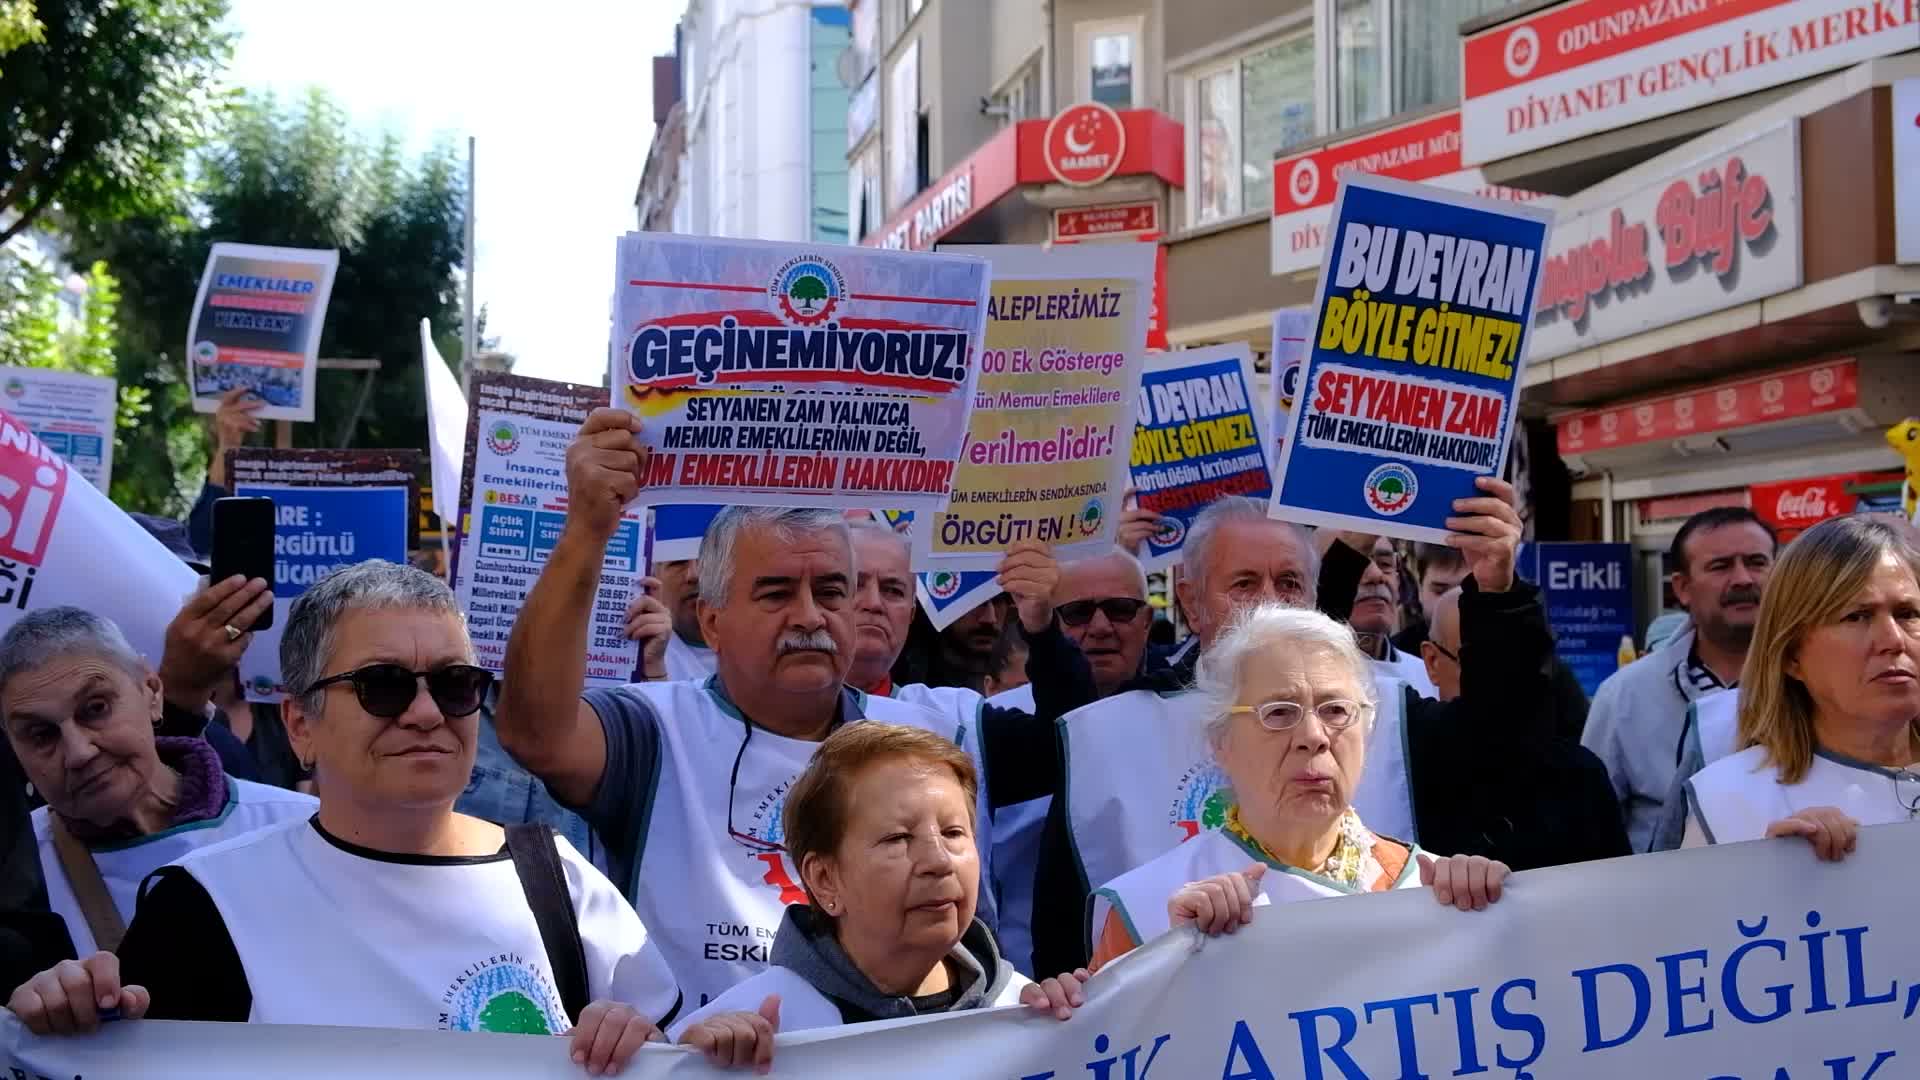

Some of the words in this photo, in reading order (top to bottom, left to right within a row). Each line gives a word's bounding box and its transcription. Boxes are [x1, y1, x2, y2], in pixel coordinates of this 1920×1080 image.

[1506, 74, 1633, 135] DİYANET
[1637, 30, 1779, 97] GENÇLİK
[1656, 157, 1775, 273] Büfe
[1291, 223, 1328, 253] DİY
[1335, 222, 1399, 293] BU
[1395, 230, 1535, 316] DEVRAN
[987, 288, 1121, 321] ALEPLERİMİZ
[1319, 289, 1418, 360] BÖYLE
[1413, 302, 1522, 381] GİTMEZ!
[632, 318, 967, 383] GEÇİNEMİYORUZ!
[982, 350, 1005, 373] 00
[1011, 350, 1033, 373] Ek
[1039, 349, 1124, 376] Gösterge
[686, 397, 782, 422] SEYYANEN
[784, 399, 825, 424] ZAM
[830, 401, 910, 426] YALNIZCA
[999, 393, 1049, 409] Memur
[1052, 386, 1121, 407] Emeklilere
[1136, 386, 1153, 427] U
[1150, 371, 1248, 425] DEVRAN
[1314, 370, 1448, 431] SEYYANEN
[1445, 391, 1502, 439] ZAM
[663, 426, 734, 449] MEMUR
[737, 423, 873, 451] EMEKLİLERİNİN
[874, 426, 927, 457] DEĞİL,
[1130, 426, 1184, 468] BÖYLE
[1179, 413, 1257, 458] GİTMEZ!
[1306, 411, 1339, 442] TÜM
[1337, 418, 1429, 457] EMEKLİLERİN
[1427, 433, 1497, 468] HAKKIDIR!
[505, 460, 561, 477] İnsanca
[639, 446, 677, 488] ÜM
[679, 450, 839, 489] EMEKLİLERİN
[842, 457, 954, 494] HAKKIDIR!
[951, 490, 968, 503] ÜM
[971, 487, 1037, 504] EMEKLİLERİN
[1039, 482, 1107, 500] SENDİKASINDA
[275, 532, 355, 556] RGÜTLÜ
[275, 560, 328, 585] ÜCAD
[473, 573, 500, 585] Bakan
[1549, 561, 1622, 590] Erikli
[469, 602, 498, 614] Emekli
[470, 631, 495, 641] mekli
[588, 667, 617, 678] LIDIR!
[706, 921, 749, 937] TÜM
[704, 943, 768, 963] ESKİ
[1221, 978, 1546, 1080] ARTIŞ
